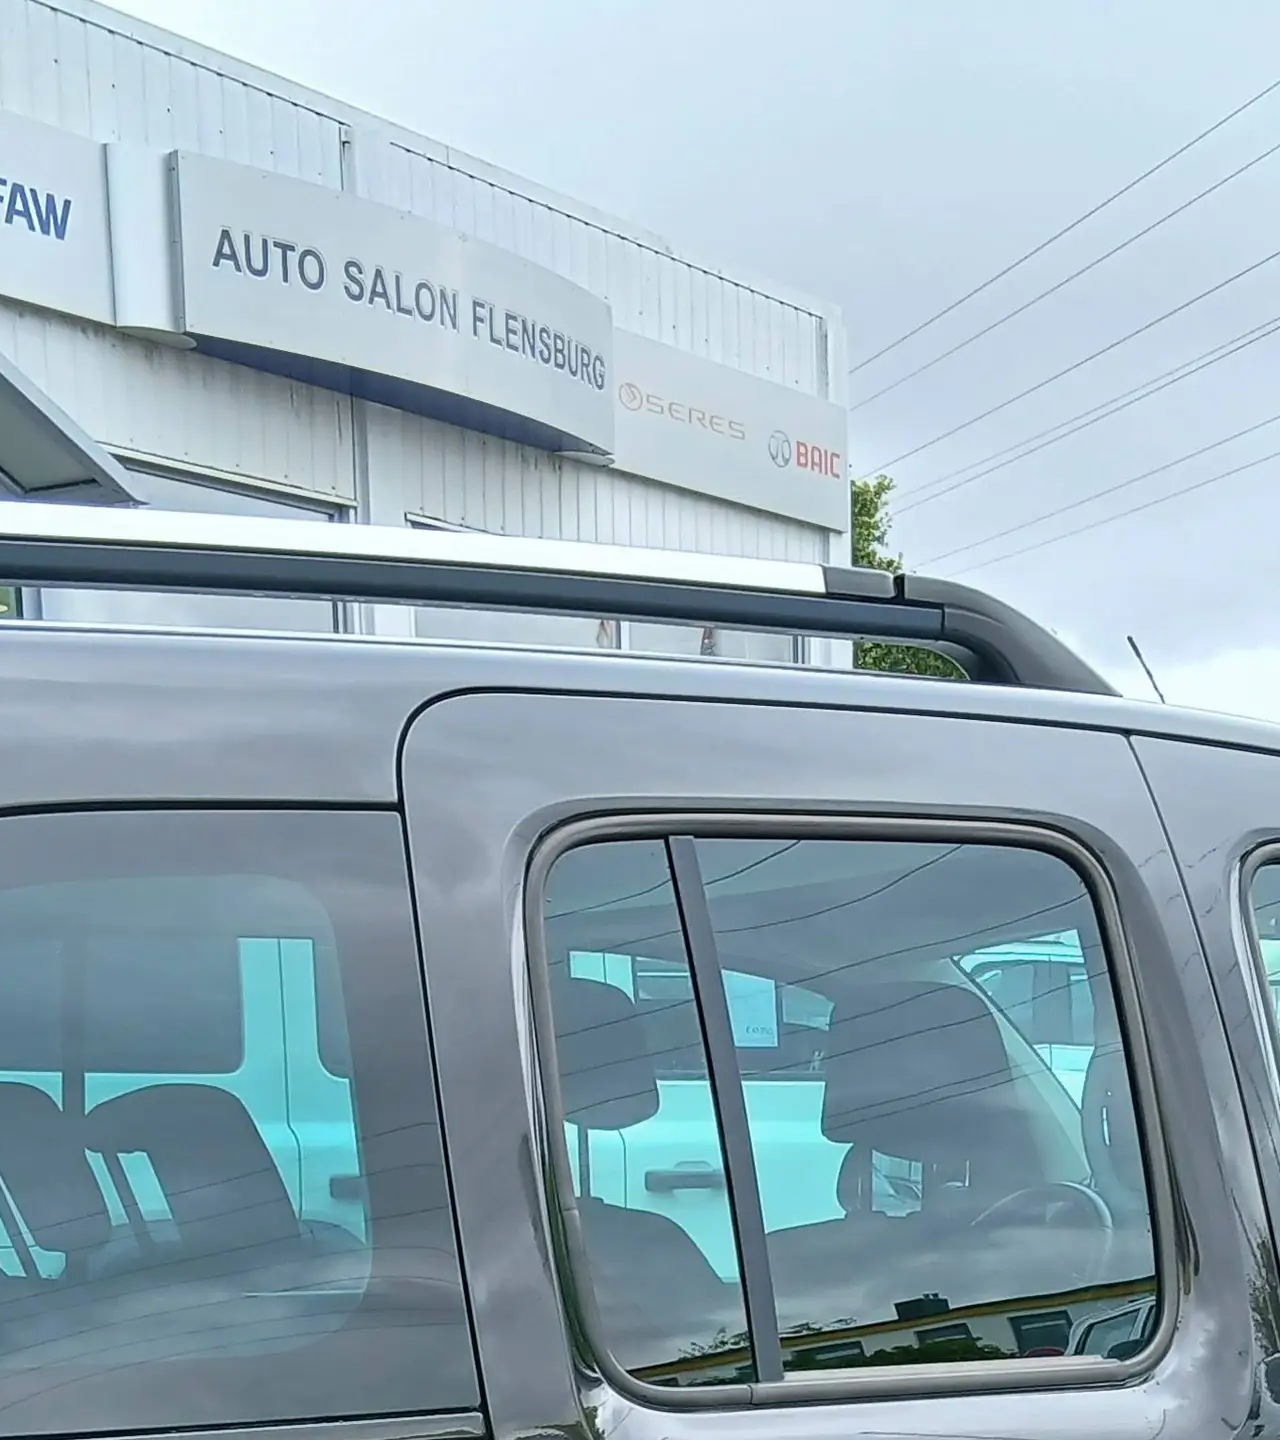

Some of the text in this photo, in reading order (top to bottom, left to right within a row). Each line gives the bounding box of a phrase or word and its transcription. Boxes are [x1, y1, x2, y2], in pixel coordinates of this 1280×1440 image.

[210, 226, 607, 392] AUTO SALON FLENSBURG
[646, 393, 746, 440] SERES
[795, 440, 841, 479] BAIC
